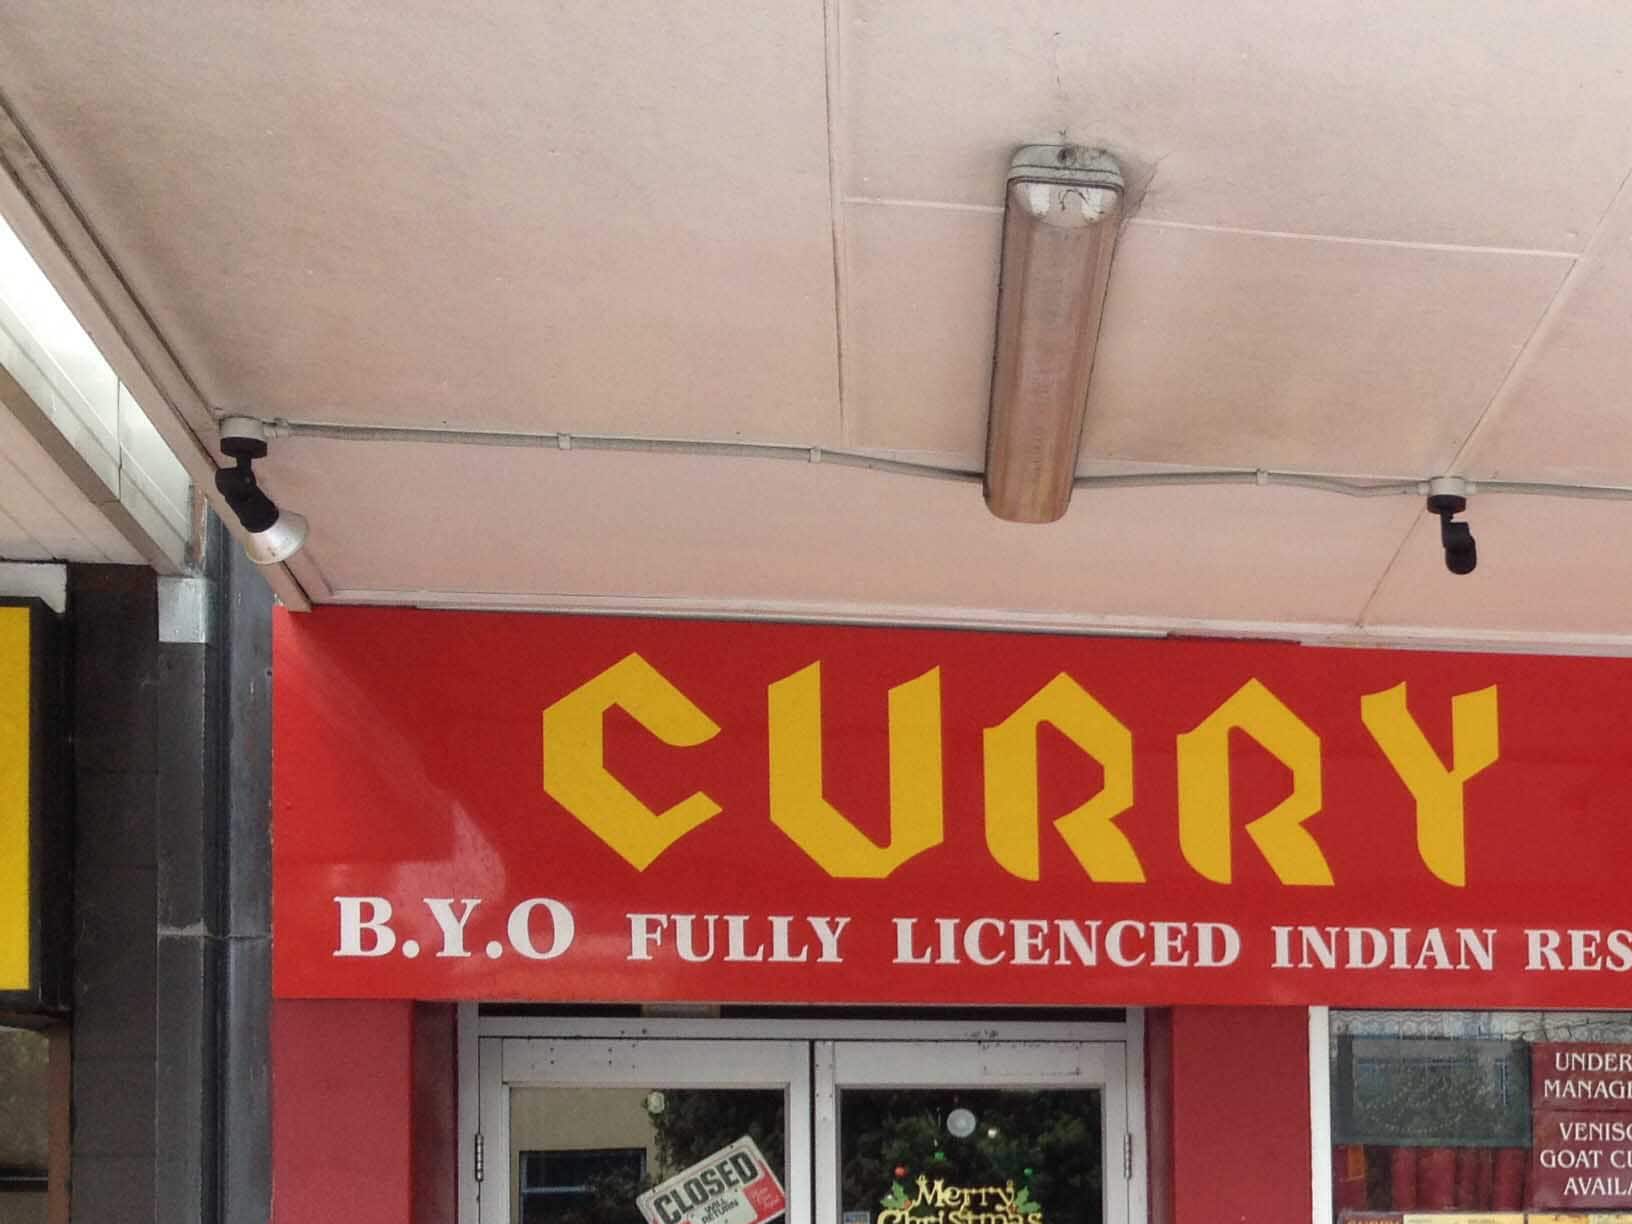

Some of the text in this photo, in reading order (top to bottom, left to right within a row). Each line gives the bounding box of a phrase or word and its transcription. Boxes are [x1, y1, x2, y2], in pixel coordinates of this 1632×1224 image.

[544, 654, 1499, 885] CURRY
[334, 896, 574, 959] B.Y.O
[627, 914, 850, 962] FULLY
[893, 918, 1240, 966] LICENCED
[1272, 926, 1496, 970] INDIAN
[1555, 1052, 1632, 1072] UNDER
[1539, 1150, 1602, 1168] GOAT
[911, 1173, 1016, 1212] Merry
